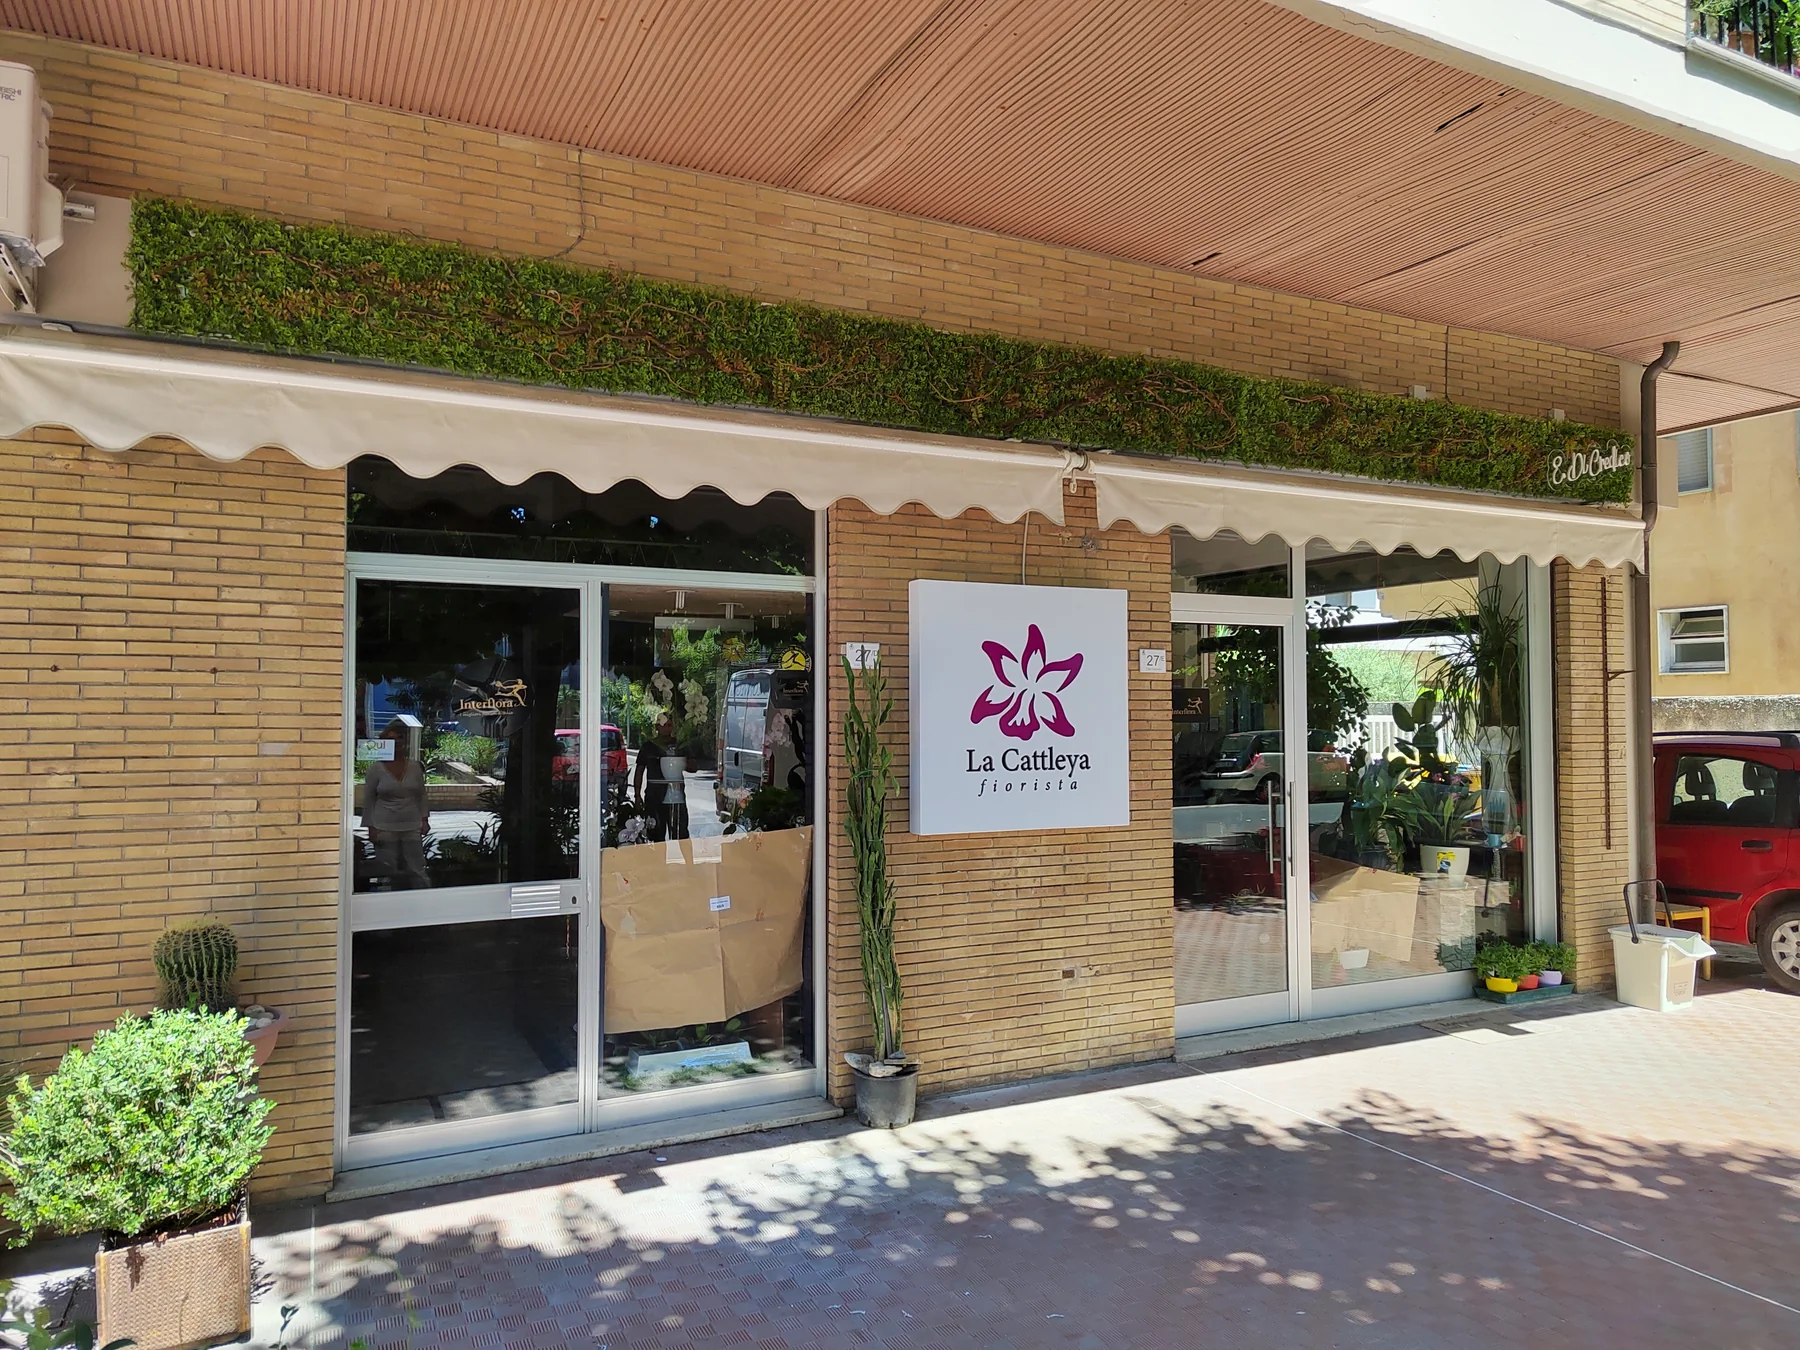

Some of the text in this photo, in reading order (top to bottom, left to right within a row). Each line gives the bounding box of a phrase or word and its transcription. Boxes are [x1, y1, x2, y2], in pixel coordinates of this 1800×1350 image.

[459, 697, 514, 710] Interflora
[965, 746, 1091, 779] La Cattleya
[977, 778, 1078, 797] fiorista
